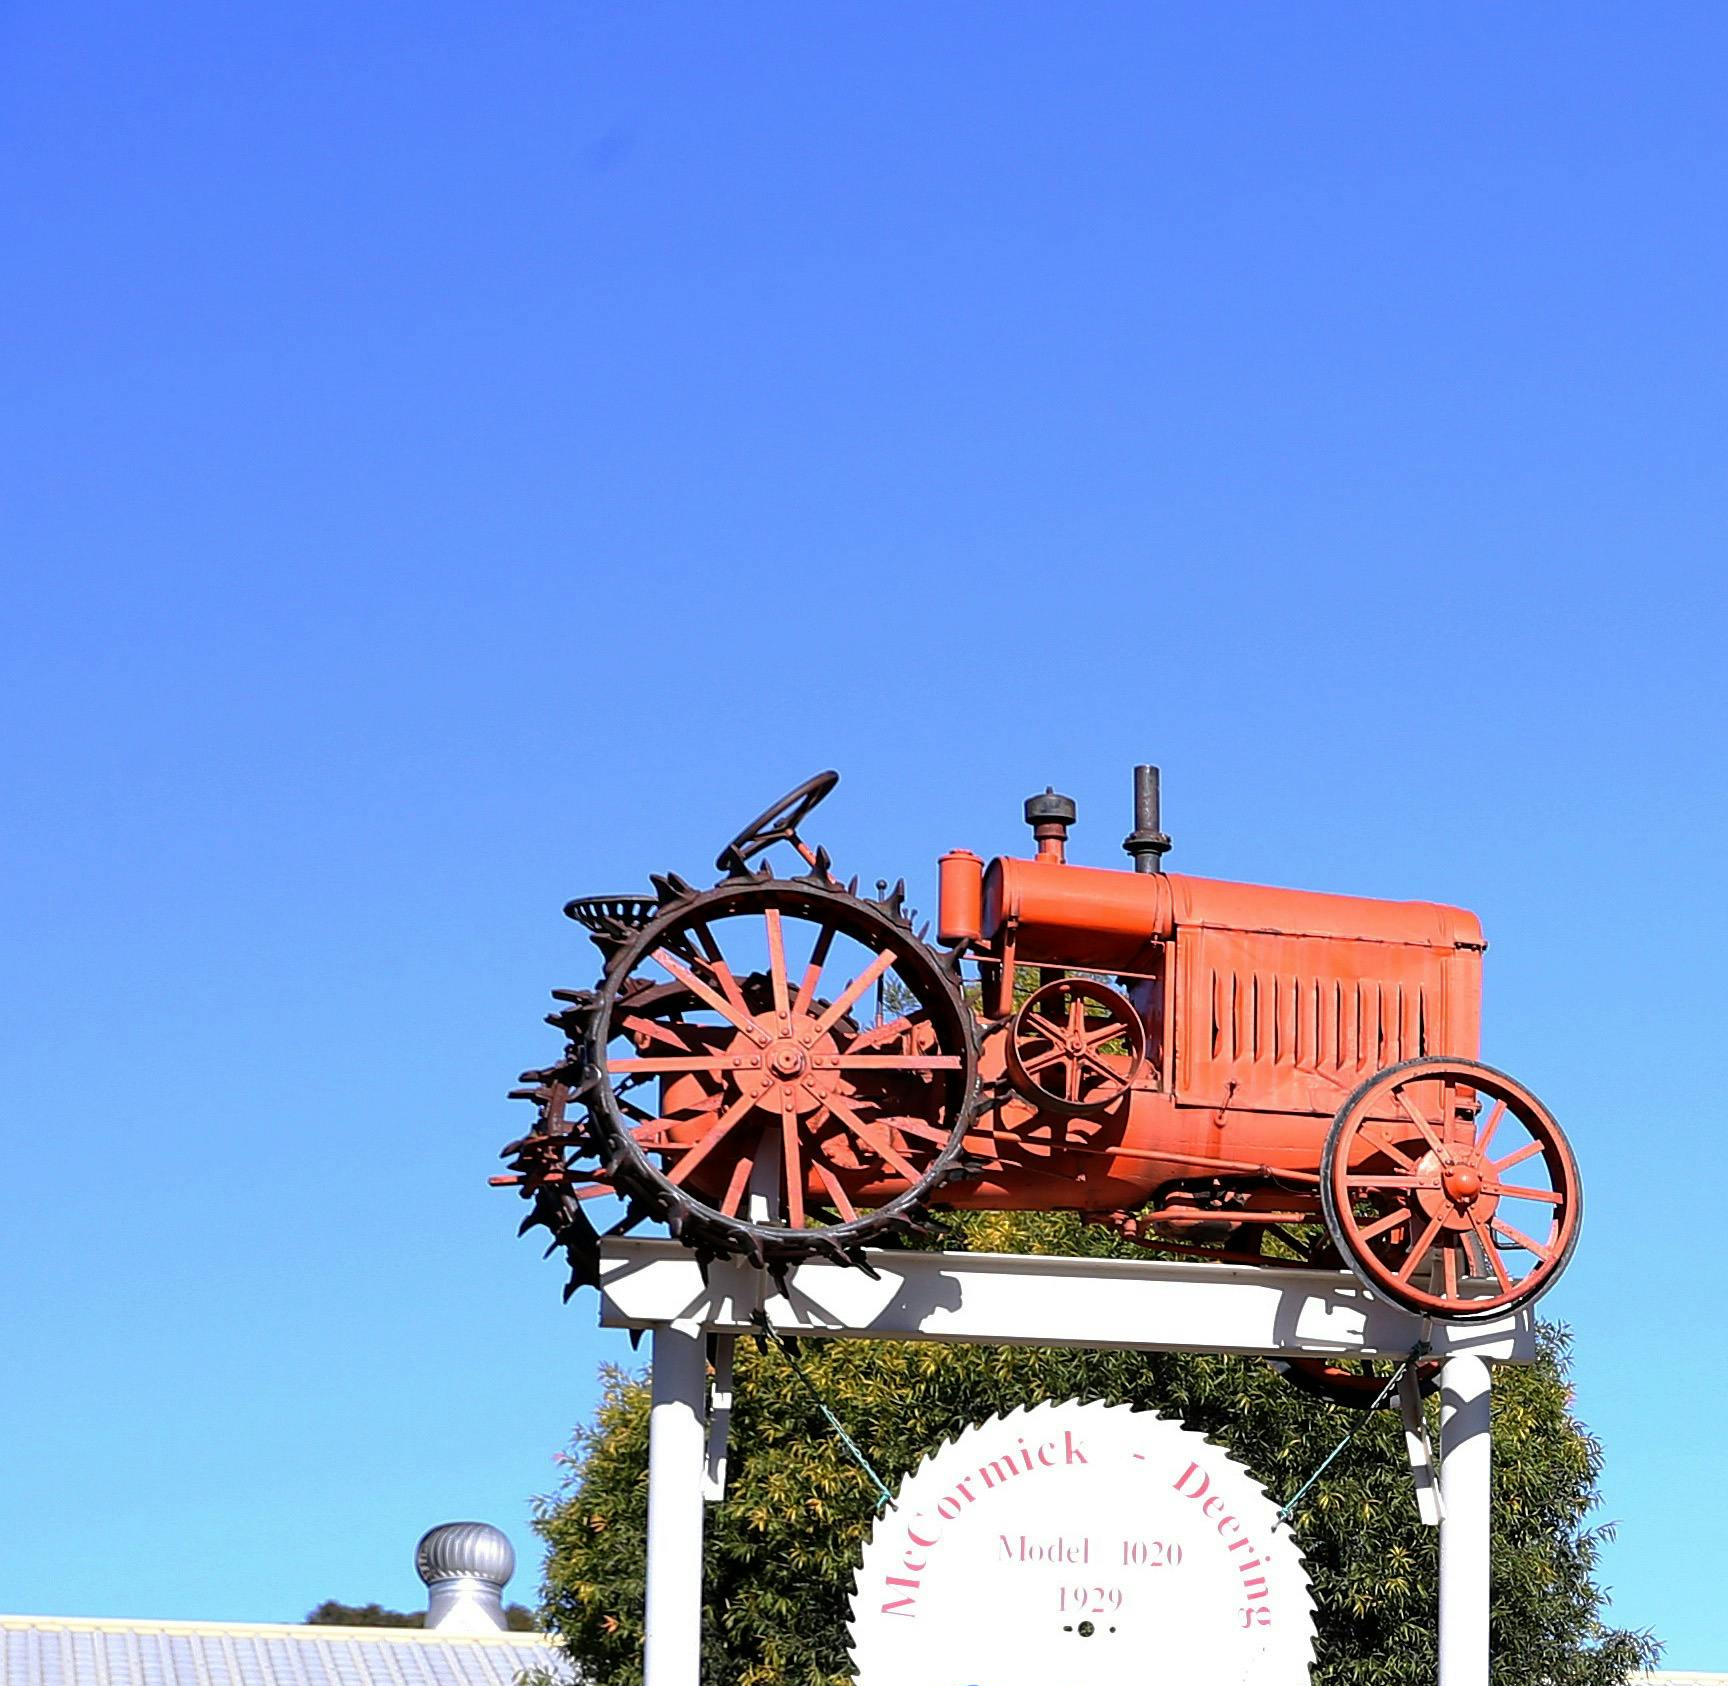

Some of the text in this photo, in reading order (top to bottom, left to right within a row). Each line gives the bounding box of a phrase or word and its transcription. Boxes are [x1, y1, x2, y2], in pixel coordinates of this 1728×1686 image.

[880, 1430, 1089, 1619] McCormick
[1172, 1460, 1272, 1629] Deering
[998, 1533, 1183, 1568] Model 1020
[1056, 1585, 1124, 1614] 1929
